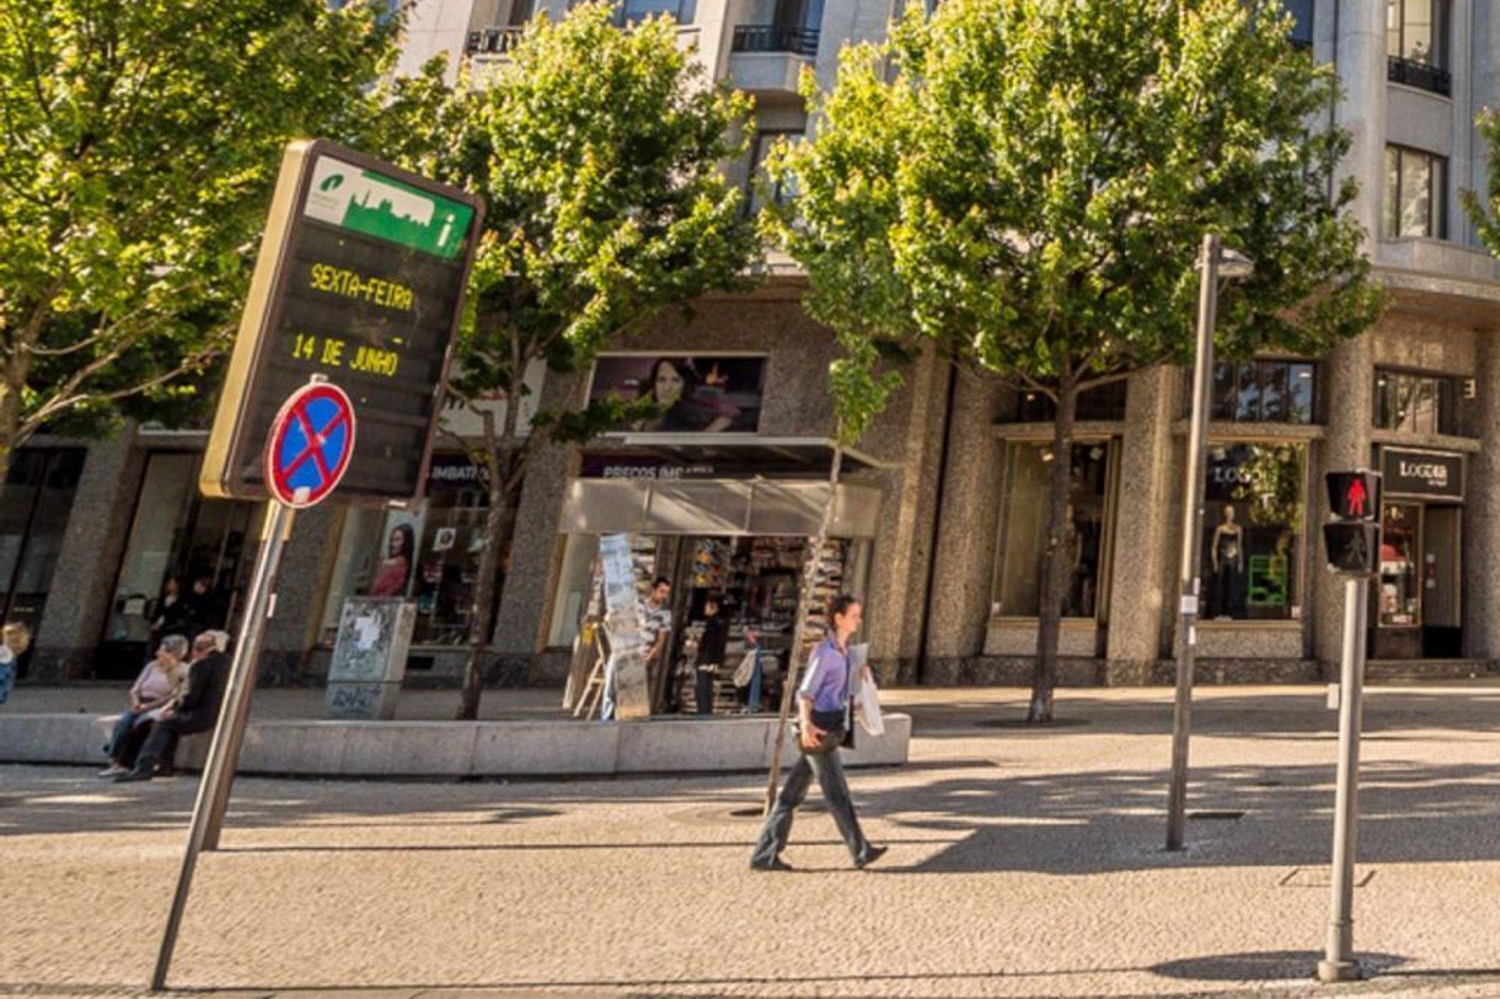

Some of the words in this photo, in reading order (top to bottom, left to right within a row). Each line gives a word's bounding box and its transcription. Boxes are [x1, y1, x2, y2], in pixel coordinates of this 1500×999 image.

[309, 262, 414, 312] SEXTA-FEIRA
[292, 333, 316, 360] 14
[320, 338, 347, 366] DE
[349, 345, 399, 377] JUNHO
